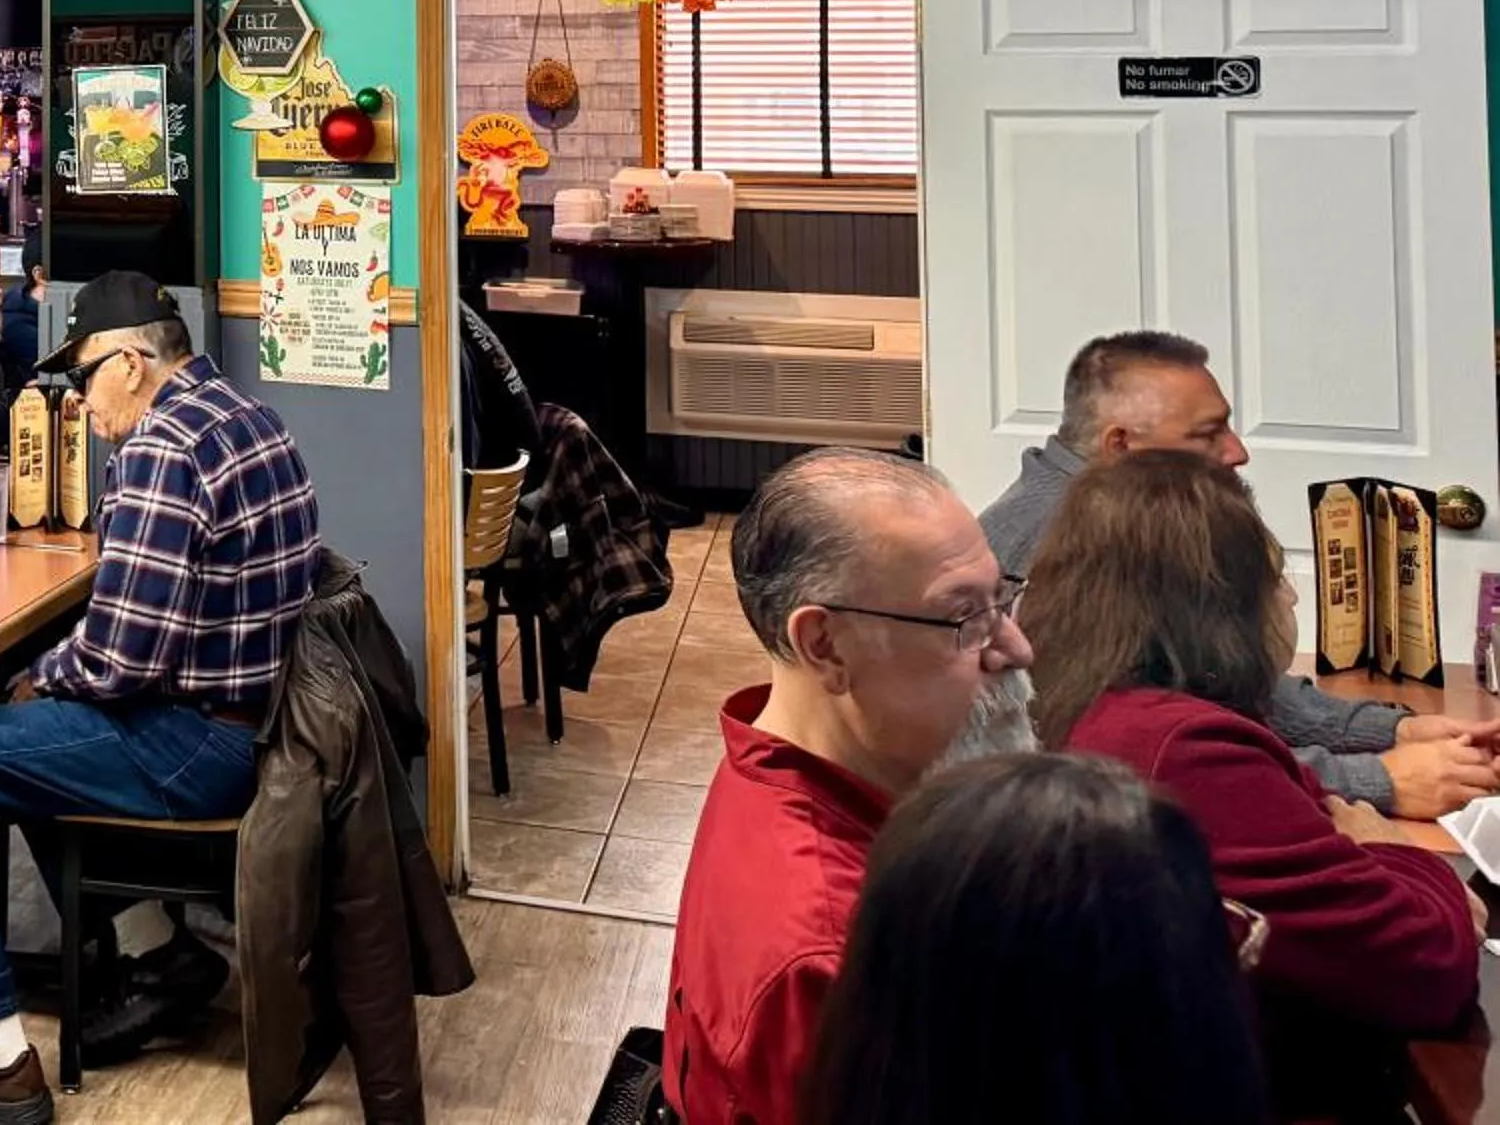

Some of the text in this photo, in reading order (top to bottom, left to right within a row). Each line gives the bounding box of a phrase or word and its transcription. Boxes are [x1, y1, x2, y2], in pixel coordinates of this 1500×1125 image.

[237, 13, 277, 30] FELIZ
[237, 36, 294, 53] NAVIDAD
[1125, 63, 1190, 76] No fumar
[296, 78, 333, 100] Jose
[1125, 78, 1211, 93] No smoking
[290, 259, 360, 279] NOS VAMOS
